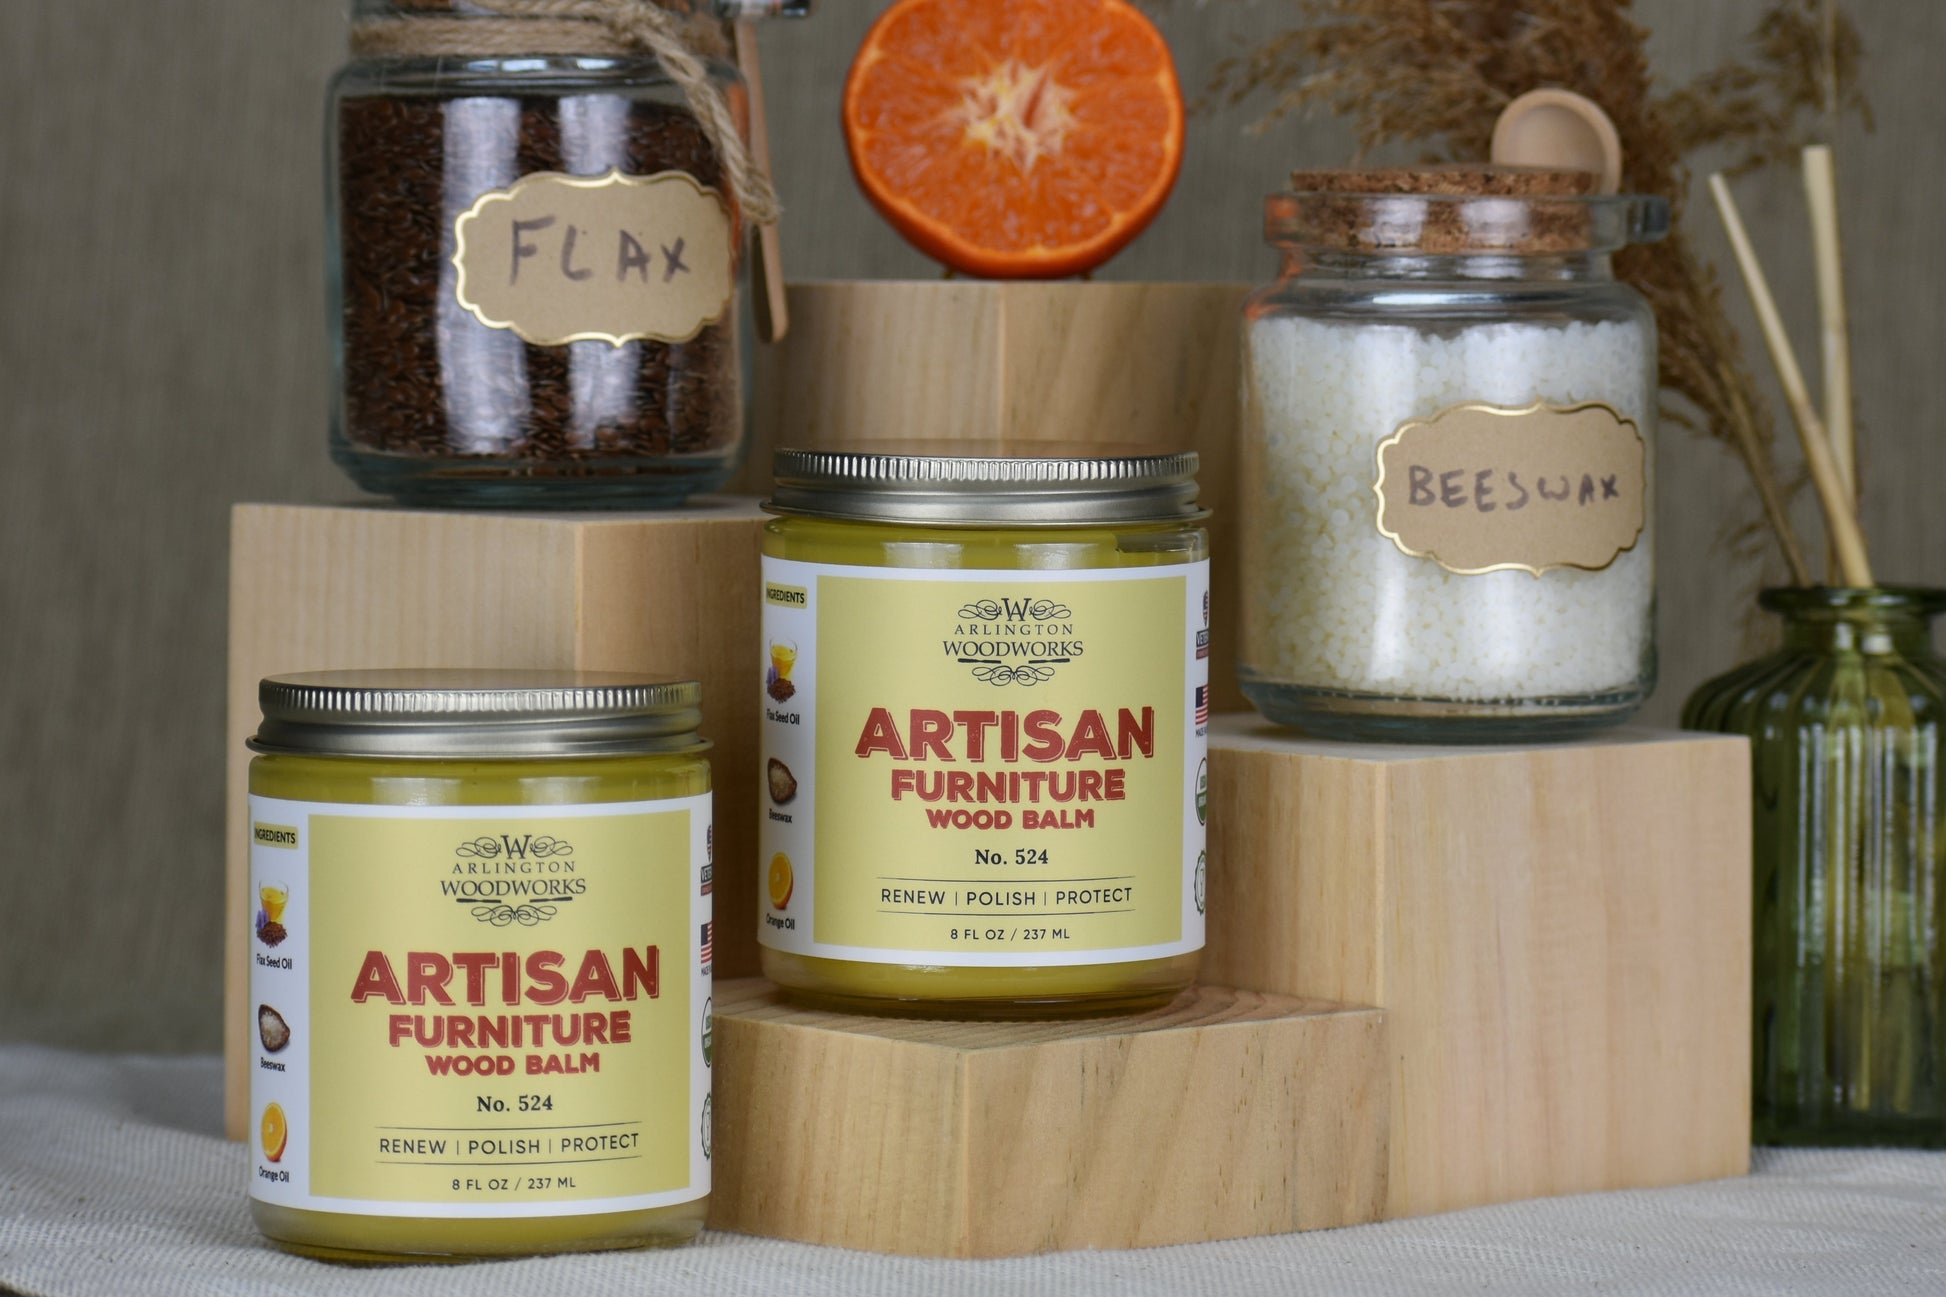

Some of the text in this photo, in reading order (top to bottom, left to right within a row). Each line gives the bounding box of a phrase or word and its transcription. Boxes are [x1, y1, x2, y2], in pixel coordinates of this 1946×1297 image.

[510, 215, 690, 286] FLAX
[1408, 465, 1620, 512] BEESWAX
[954, 624, 1073, 636] ARLINGTON
[943, 641, 1084, 657] WOODWORKS
[790, 713, 799, 725] Oil
[855, 706, 1154, 763] ARTISAN
[891, 768, 1126, 803] FURNITURE
[926, 809, 1094, 830] WOOD BALM
[975, 849, 1049, 865] No. 524
[452, 861, 575, 874] ARLINGTON
[441, 880, 586, 896] WOODWORKS
[881, 887, 1133, 906] RENEW POLISH PROTECT
[785, 918, 795, 930] Oil
[950, 929, 959, 940] 8
[964, 929, 980, 940] FL
[985, 929, 1004, 940] OZ
[1023, 929, 1046, 940] 237
[1052, 928, 1070, 940] ML
[282, 958, 292, 970] Oil
[350, 945, 660, 1007] ARTISAN
[388, 1010, 631, 1049] FURNITURE
[425, 1053, 600, 1076] WOOD BALM
[477, 1096, 553, 1112] No. 524
[379, 1134, 639, 1154] RENEW POLISH PROTECT
[280, 1170, 289, 1183] Oil
[452, 1179, 461, 1190] 8
[467, 1179, 484, 1190] FL
[489, 1178, 509, 1190] OZ
[528, 1177, 552, 1190] 237
[558, 1177, 576, 1189] ML
